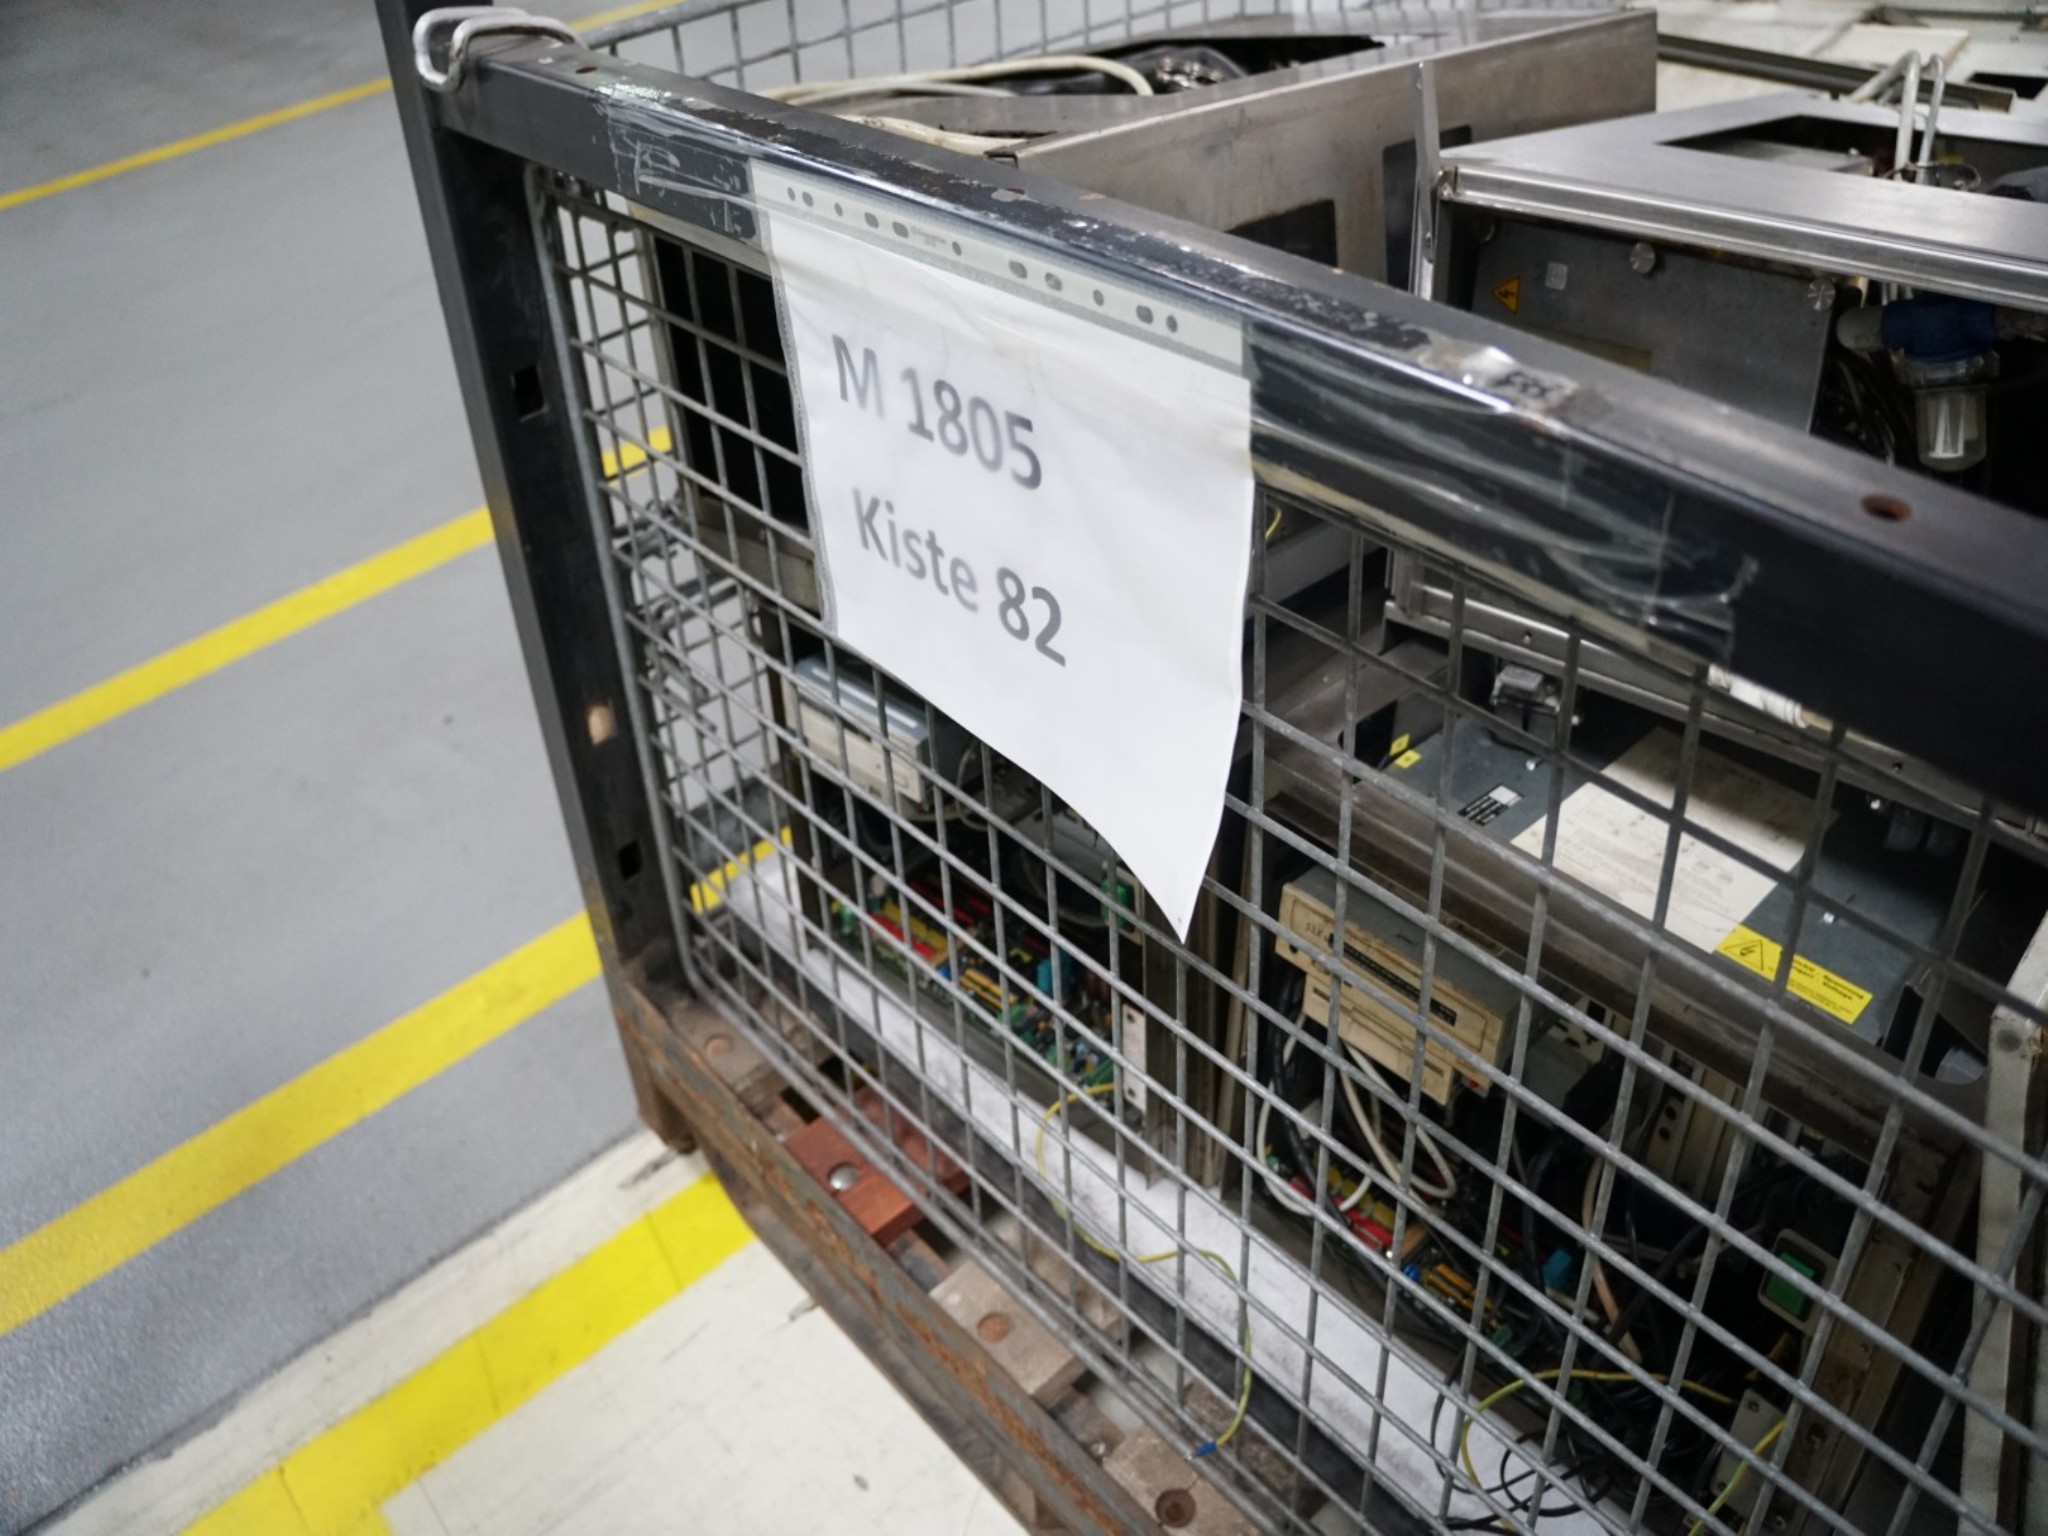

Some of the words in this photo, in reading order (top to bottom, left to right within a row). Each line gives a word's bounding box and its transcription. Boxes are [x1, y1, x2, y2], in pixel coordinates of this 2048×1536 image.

[832, 334, 885, 420] M
[901, 367, 1042, 490] 1805
[852, 487, 978, 613] Kiste
[996, 567, 1066, 667] 82
